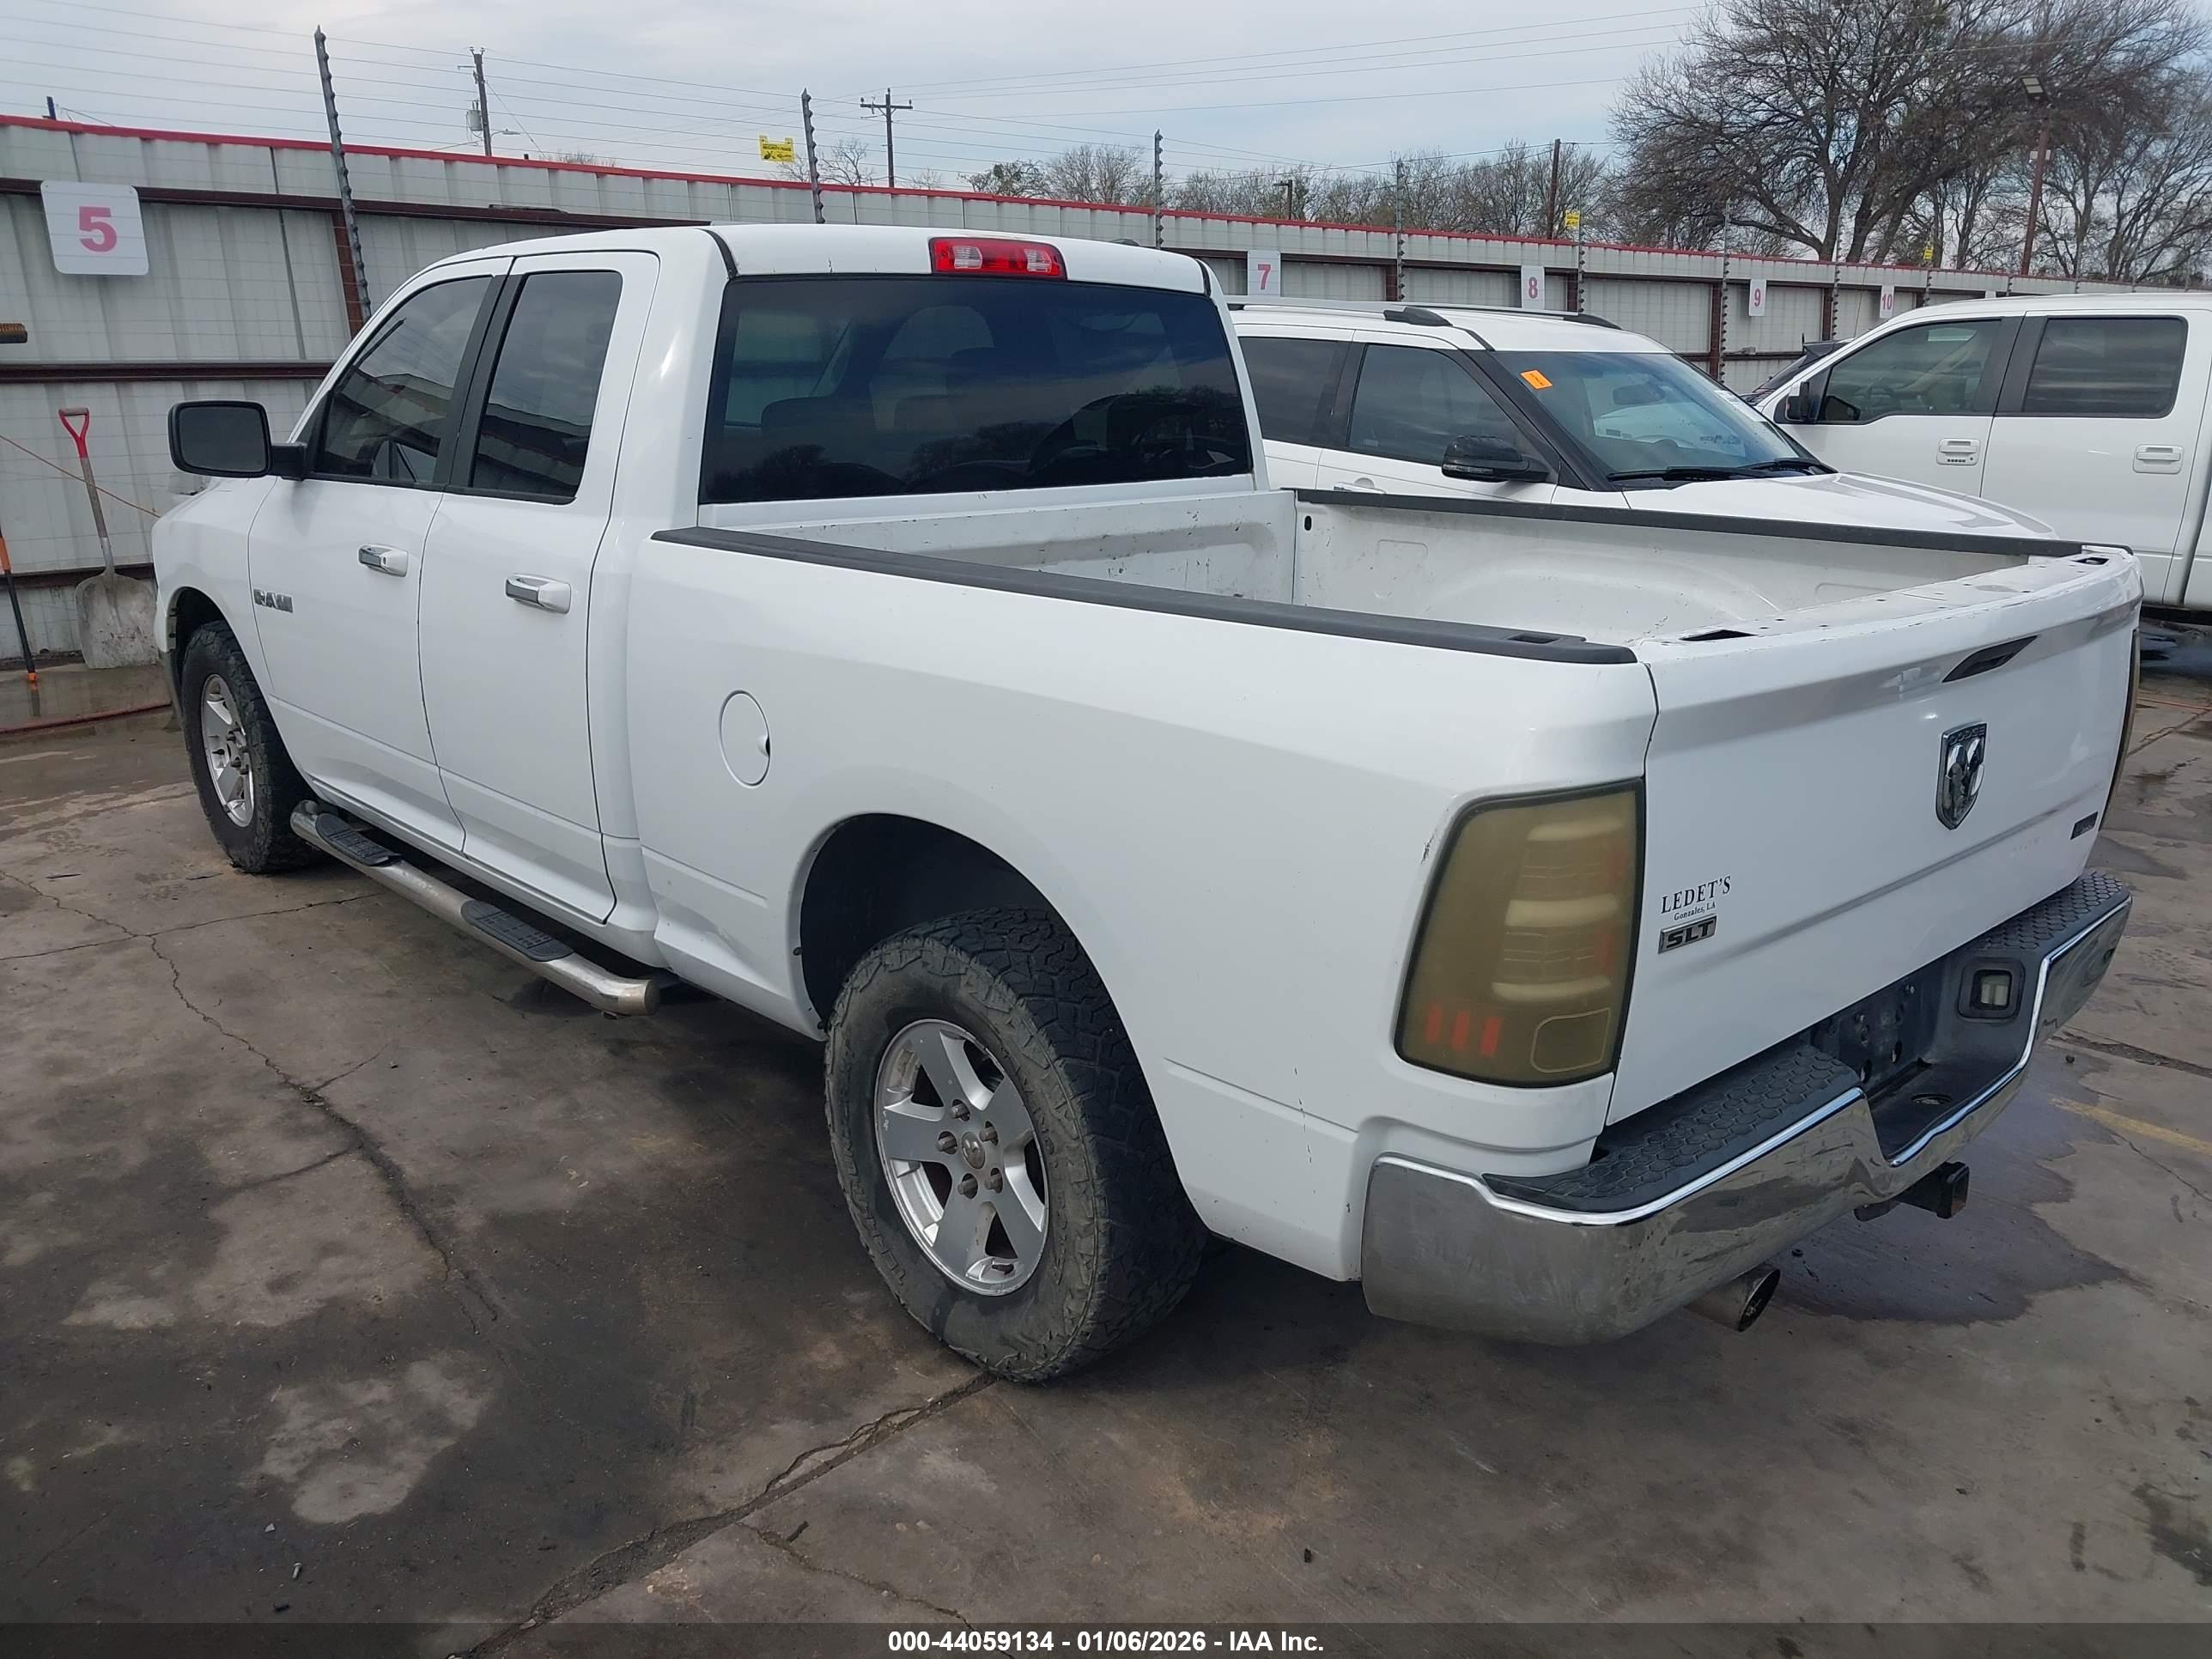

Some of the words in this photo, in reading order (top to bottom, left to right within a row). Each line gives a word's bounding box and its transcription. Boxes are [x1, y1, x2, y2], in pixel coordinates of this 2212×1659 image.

[79, 206, 118, 252] 5
[1257, 264, 1272, 290] 7
[1528, 276, 1538, 299] 8
[1754, 289, 1761, 307] 9
[1882, 294, 1893, 310] 10
[253, 588, 293, 613] RAM
[1661, 876, 1731, 915] LEDET'S
[1674, 906, 1705, 921] Gonzales,
[1706, 901, 1716, 911] LA
[1666, 920, 1714, 949] SLT
